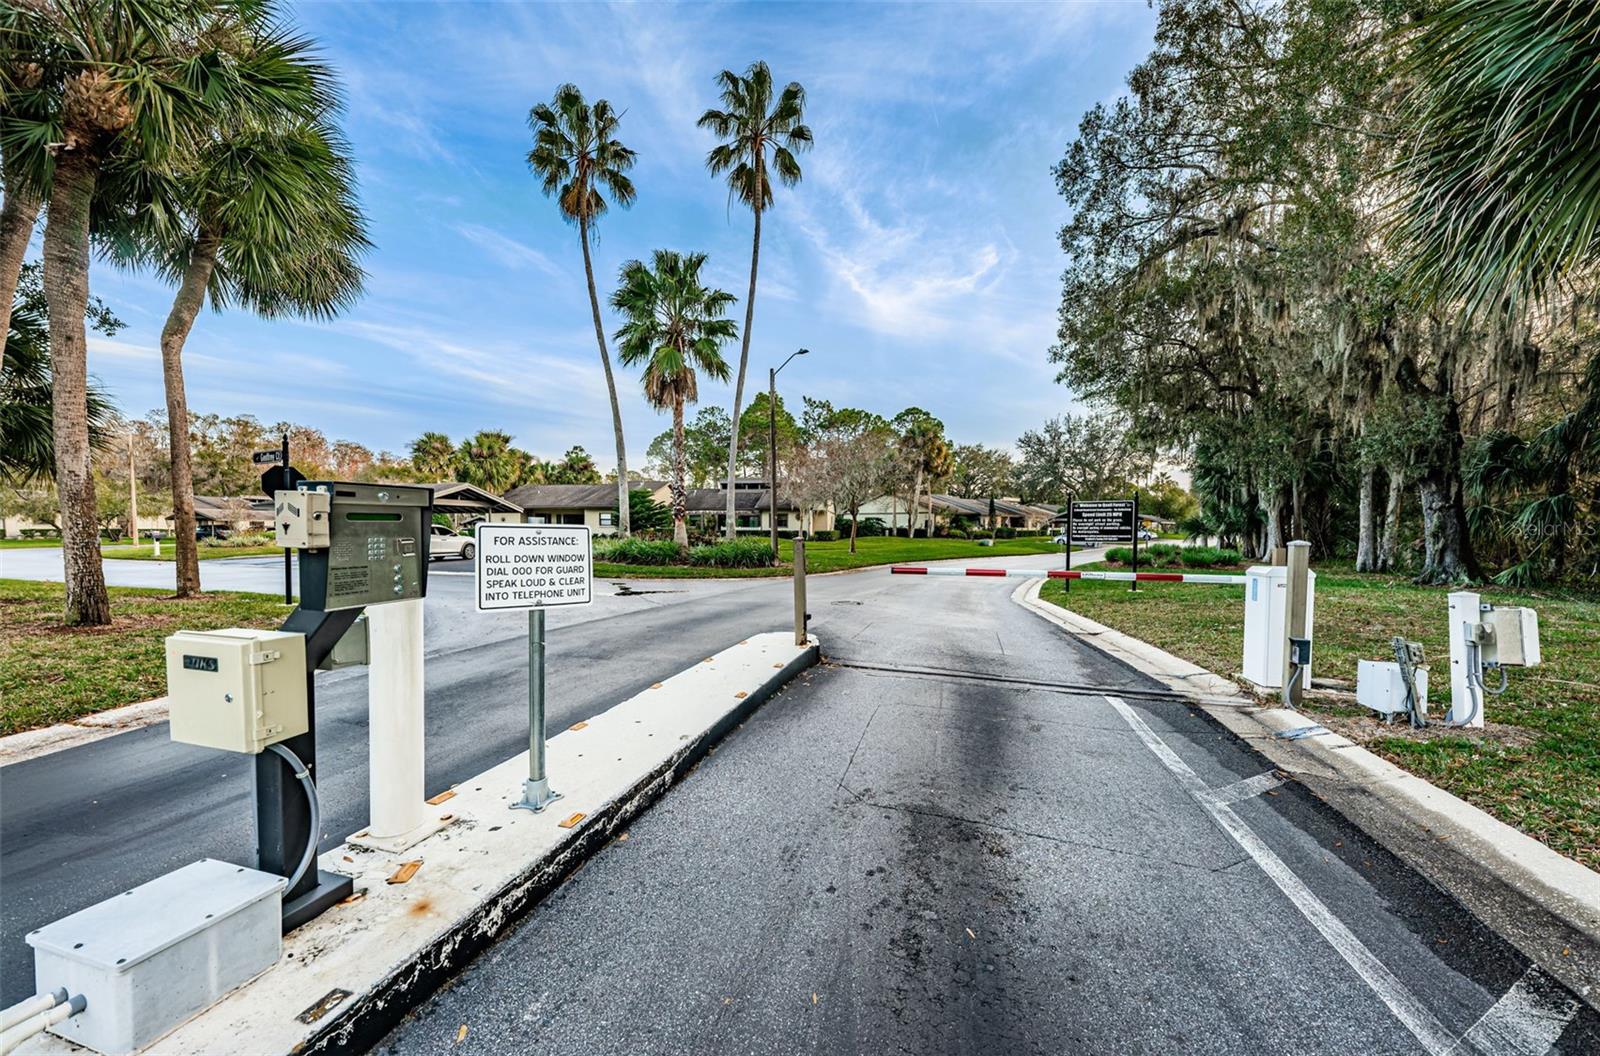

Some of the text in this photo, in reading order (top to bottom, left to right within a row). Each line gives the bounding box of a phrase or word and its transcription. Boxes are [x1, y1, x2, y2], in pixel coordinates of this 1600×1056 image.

[493, 536, 579, 546] FOR ASSISTANCE:
[485, 554, 586, 564] ROLL DOWN WINDOW
[486, 567, 509, 576] DIAL
[535, 566, 553, 575] FOR
[556, 566, 584, 574] GUARD
[486, 577, 585, 589] SPEAK LOUD & CLEAR
[485, 588, 586, 601] INTO TELEPHONE UNIT
